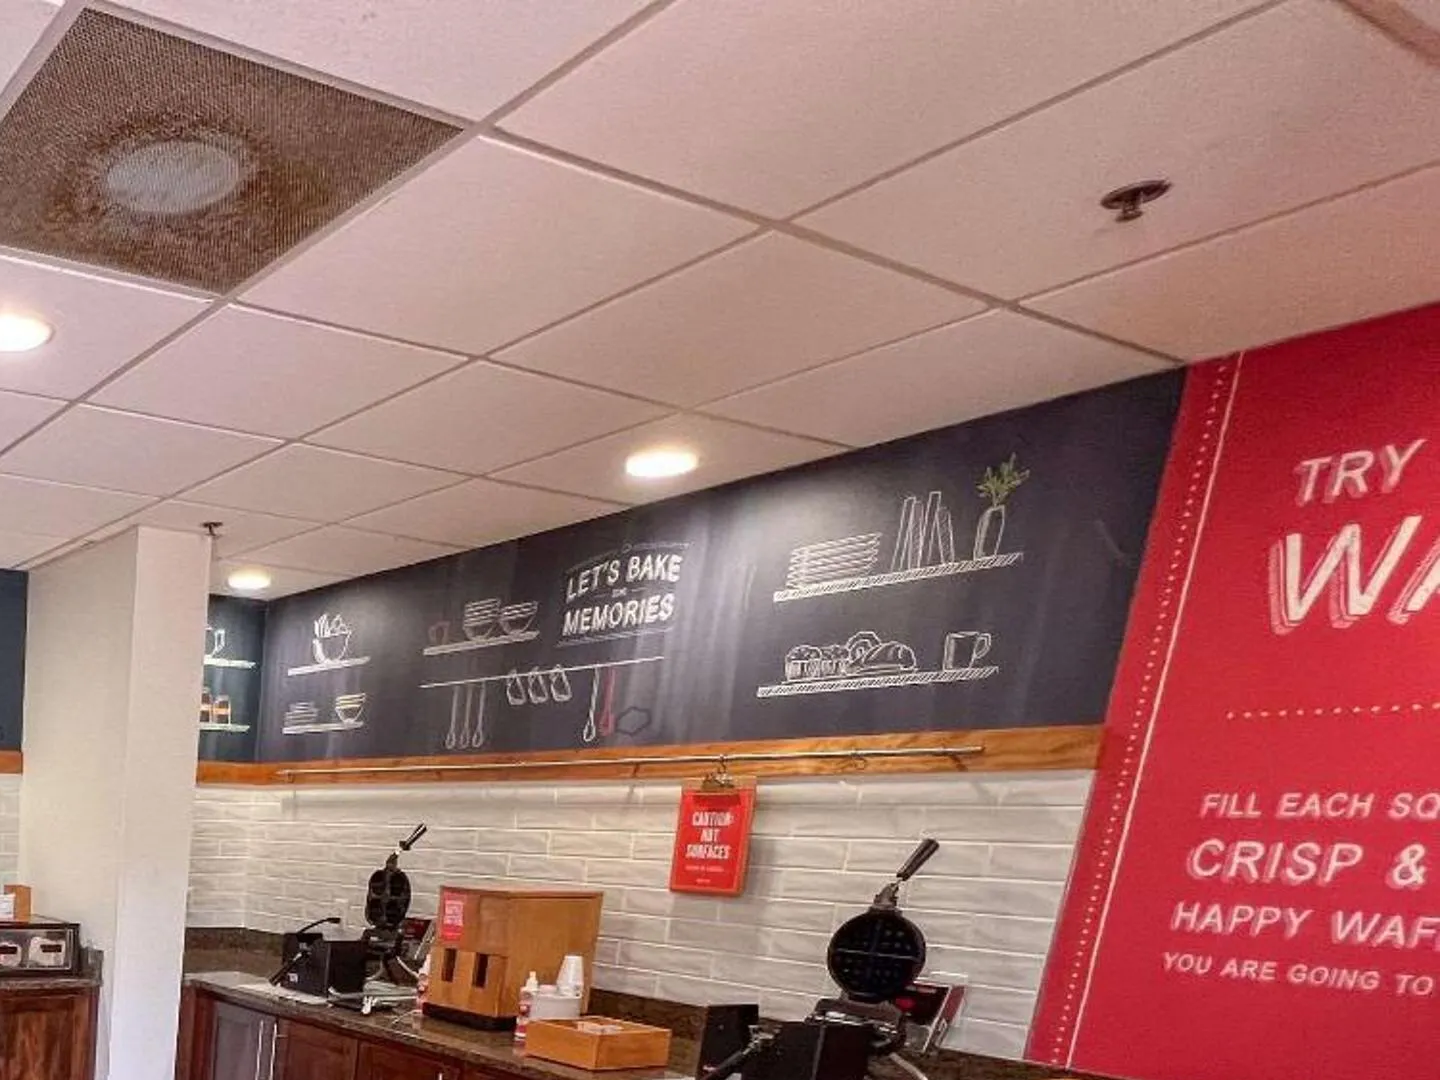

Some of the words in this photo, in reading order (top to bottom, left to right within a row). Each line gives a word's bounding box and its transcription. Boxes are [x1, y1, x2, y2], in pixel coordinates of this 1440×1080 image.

[1294, 438, 1428, 507] TRY
[566, 560, 620, 603] LET'S
[626, 553, 683, 583] BAKE
[562, 592, 675, 637] MEMORIES
[1200, 792, 1262, 819] FILL
[1276, 792, 1375, 819] EACH
[685, 844, 731, 860] SURFACES
[1187, 838, 1364, 887] CRISP
[1385, 843, 1428, 890] &
[1170, 902, 1314, 940] HAPPY
[1332, 910, 1440, 951] WAF
[1163, 951, 1212, 974] YOU
[1220, 957, 1277, 982] ARE
[1288, 963, 1381, 992] GOING
[1396, 974, 1434, 996] TO
